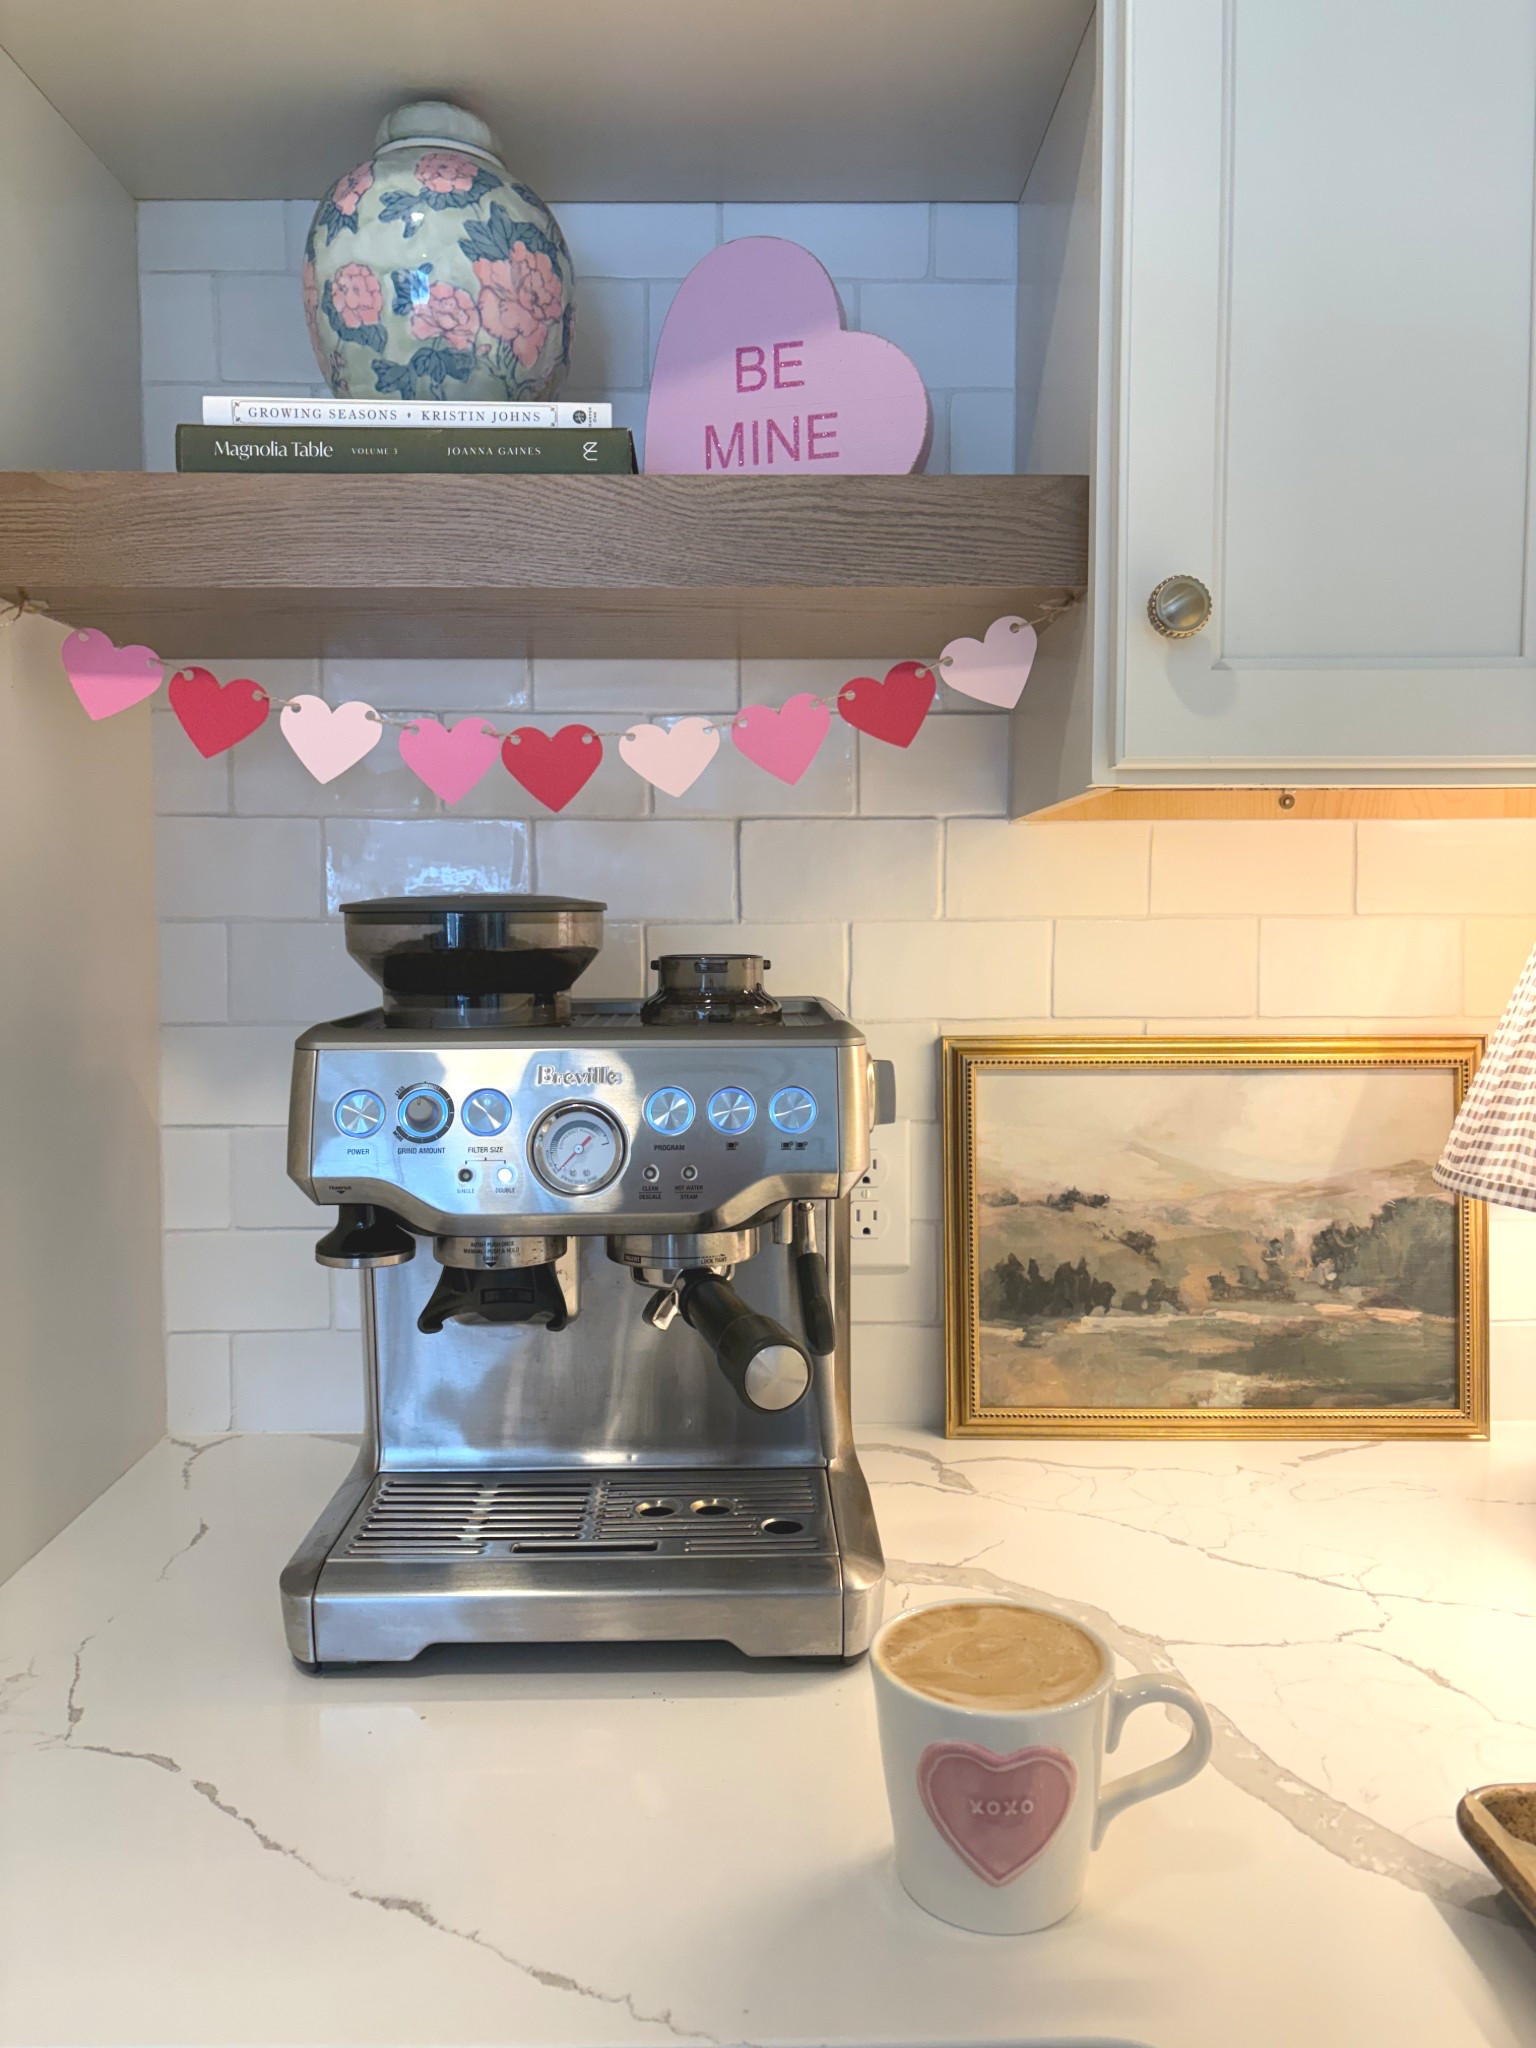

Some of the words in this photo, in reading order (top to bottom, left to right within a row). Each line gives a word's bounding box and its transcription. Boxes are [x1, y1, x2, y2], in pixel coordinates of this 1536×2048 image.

[735, 340, 805, 393] BE
[248, 407, 322, 419] GROWING
[329, 408, 398, 420] SEASONS
[422, 410, 486, 422] KRISTIN
[491, 411, 541, 423] JOHNS
[705, 411, 840, 470] MINE
[214, 441, 288, 460] Magnolia
[291, 441, 334, 458] Table
[351, 447, 389, 455] VOLUME
[393, 447, 398, 455] 3
[447, 447, 493, 456] JOANNA
[498, 447, 541, 456] GAINES
[537, 1065, 620, 1085] Breville
[397, 1147, 417, 1155] GRIND
[969, 1799, 1034, 1816] XOXO
